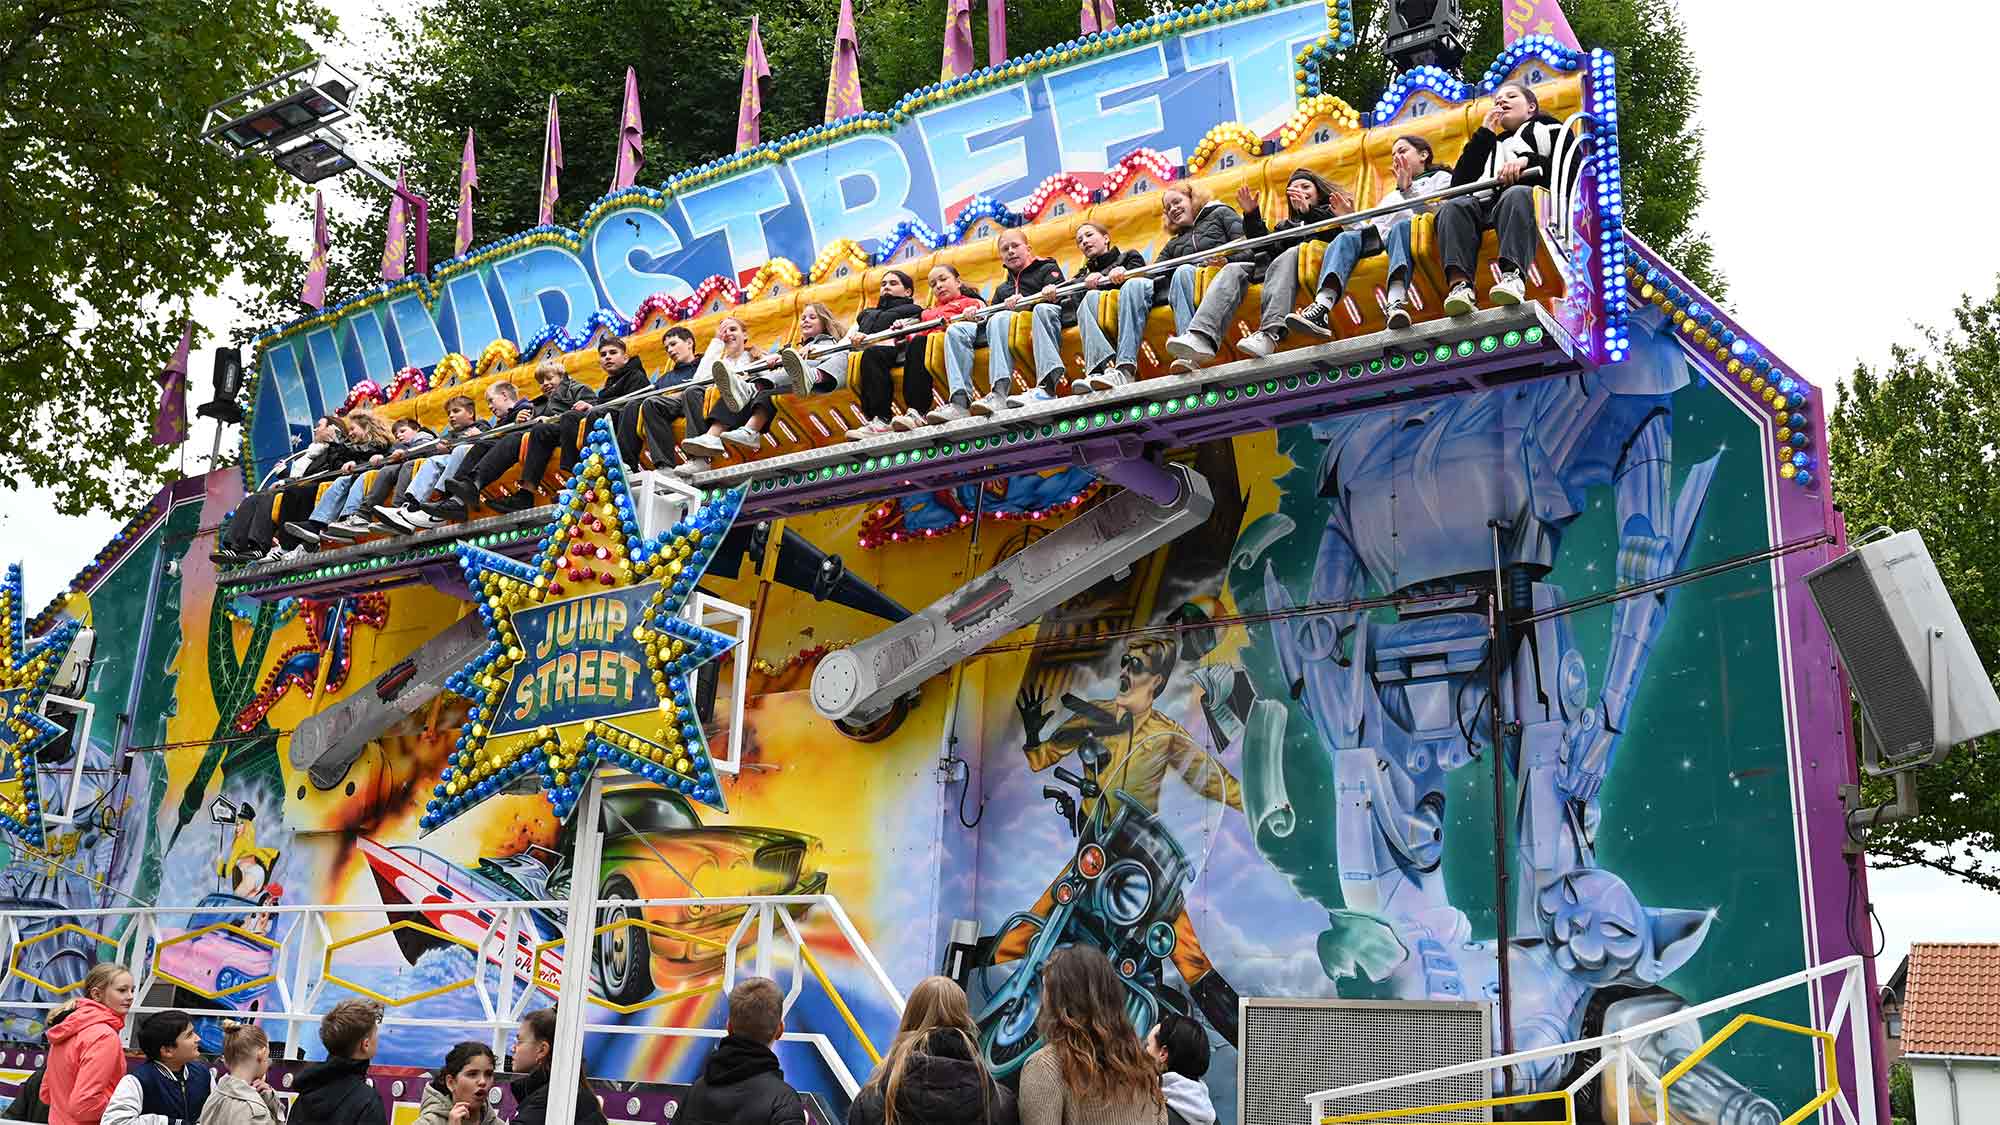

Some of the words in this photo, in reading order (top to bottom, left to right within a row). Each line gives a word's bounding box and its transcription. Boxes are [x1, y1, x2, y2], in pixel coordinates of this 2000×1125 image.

[1524, 69, 1542, 86] 18
[1411, 101, 1427, 118] 17
[1314, 129, 1329, 144] 16
[1219, 155, 1234, 170] 15
[1133, 180, 1148, 194] 14
[1053, 203, 1065, 217] 13
[977, 225, 990, 238] 12
[904, 246, 915, 258] 11
[835, 265, 849, 278] 10
[772, 285, 780, 297] 9
[654, 318, 662, 329] 7
[545, 346, 552, 359] 5
[536, 598, 628, 660] JUMP
[513, 649, 641, 721] STREET
